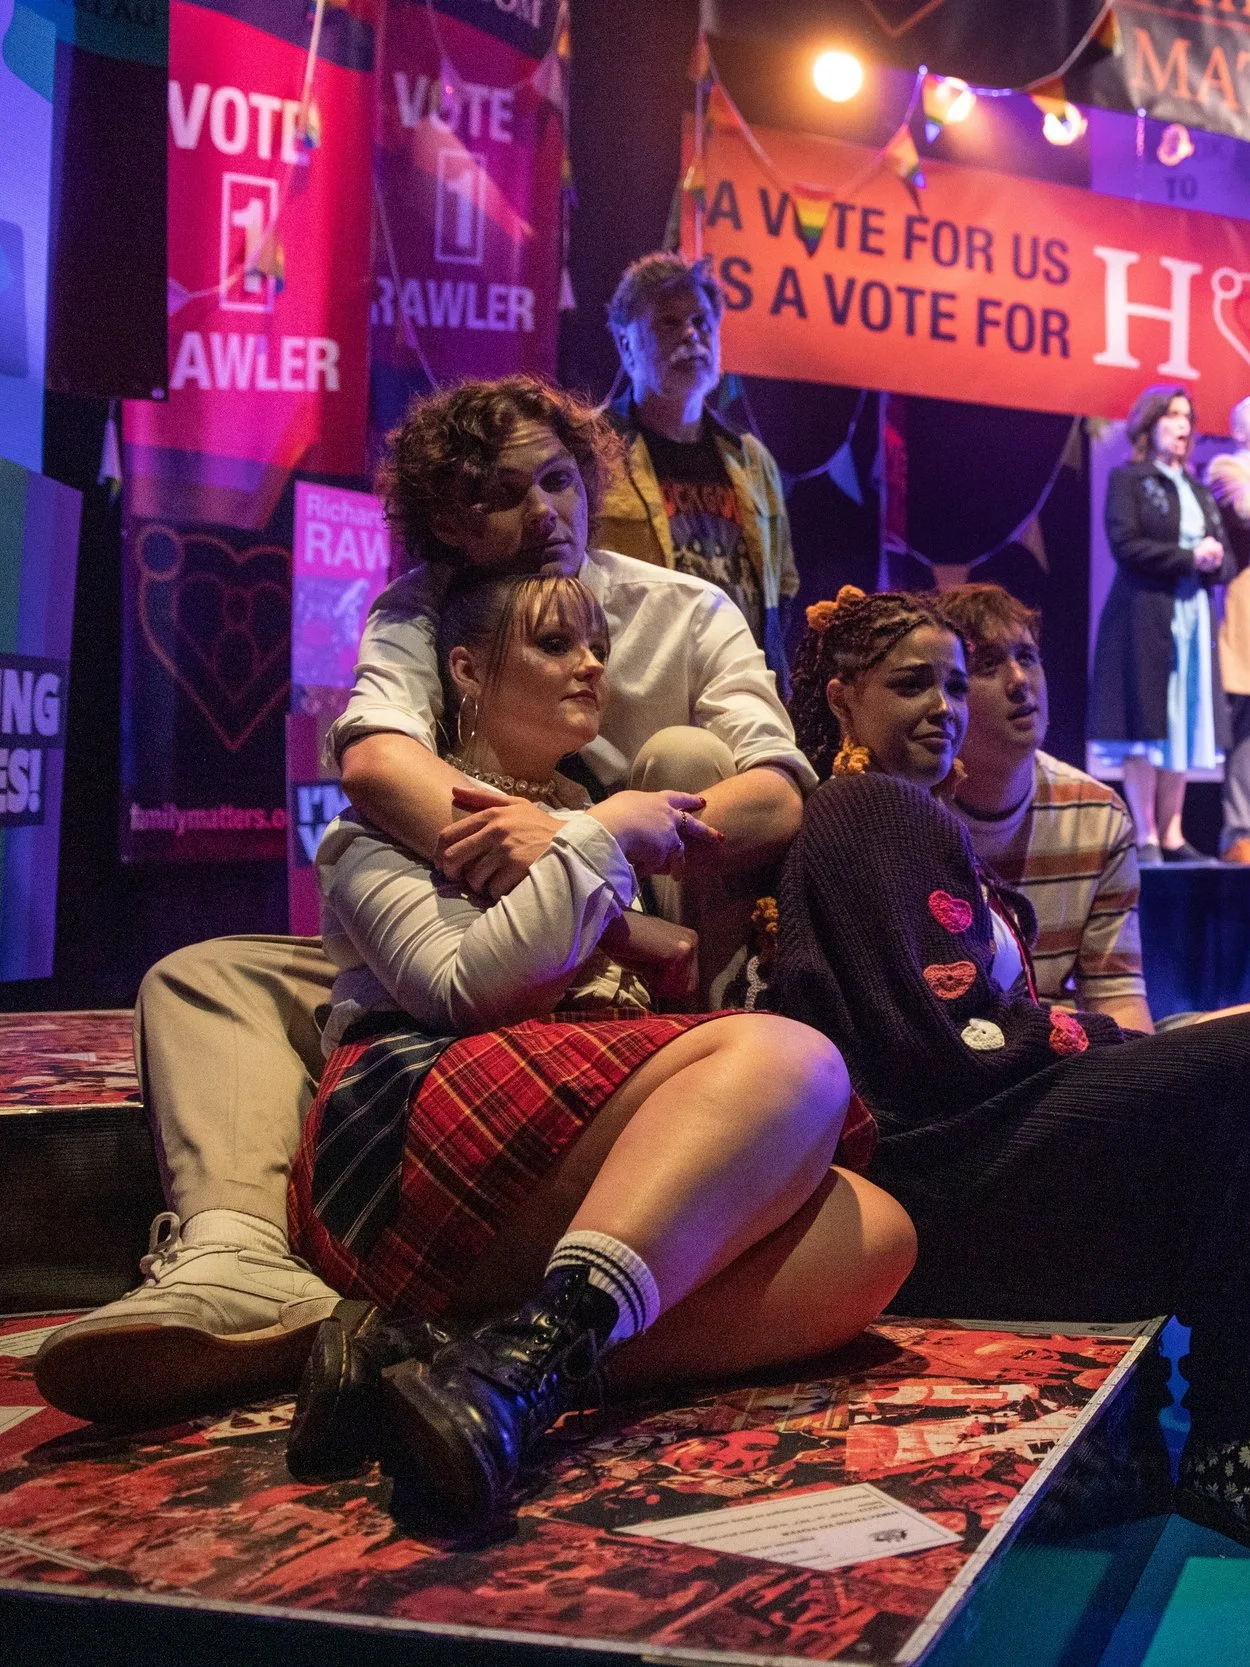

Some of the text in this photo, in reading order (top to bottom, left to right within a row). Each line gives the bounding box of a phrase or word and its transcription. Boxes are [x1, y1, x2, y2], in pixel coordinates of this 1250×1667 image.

[168, 80, 311, 165] VOTE
[393, 71, 515, 143] VOTE
[706, 179, 1071, 286] A VTE FOR US
[716, 255, 1071, 360] S A VOTE FOR
[170, 331, 341, 392] AWLER
[0, 668, 61, 737] NG
